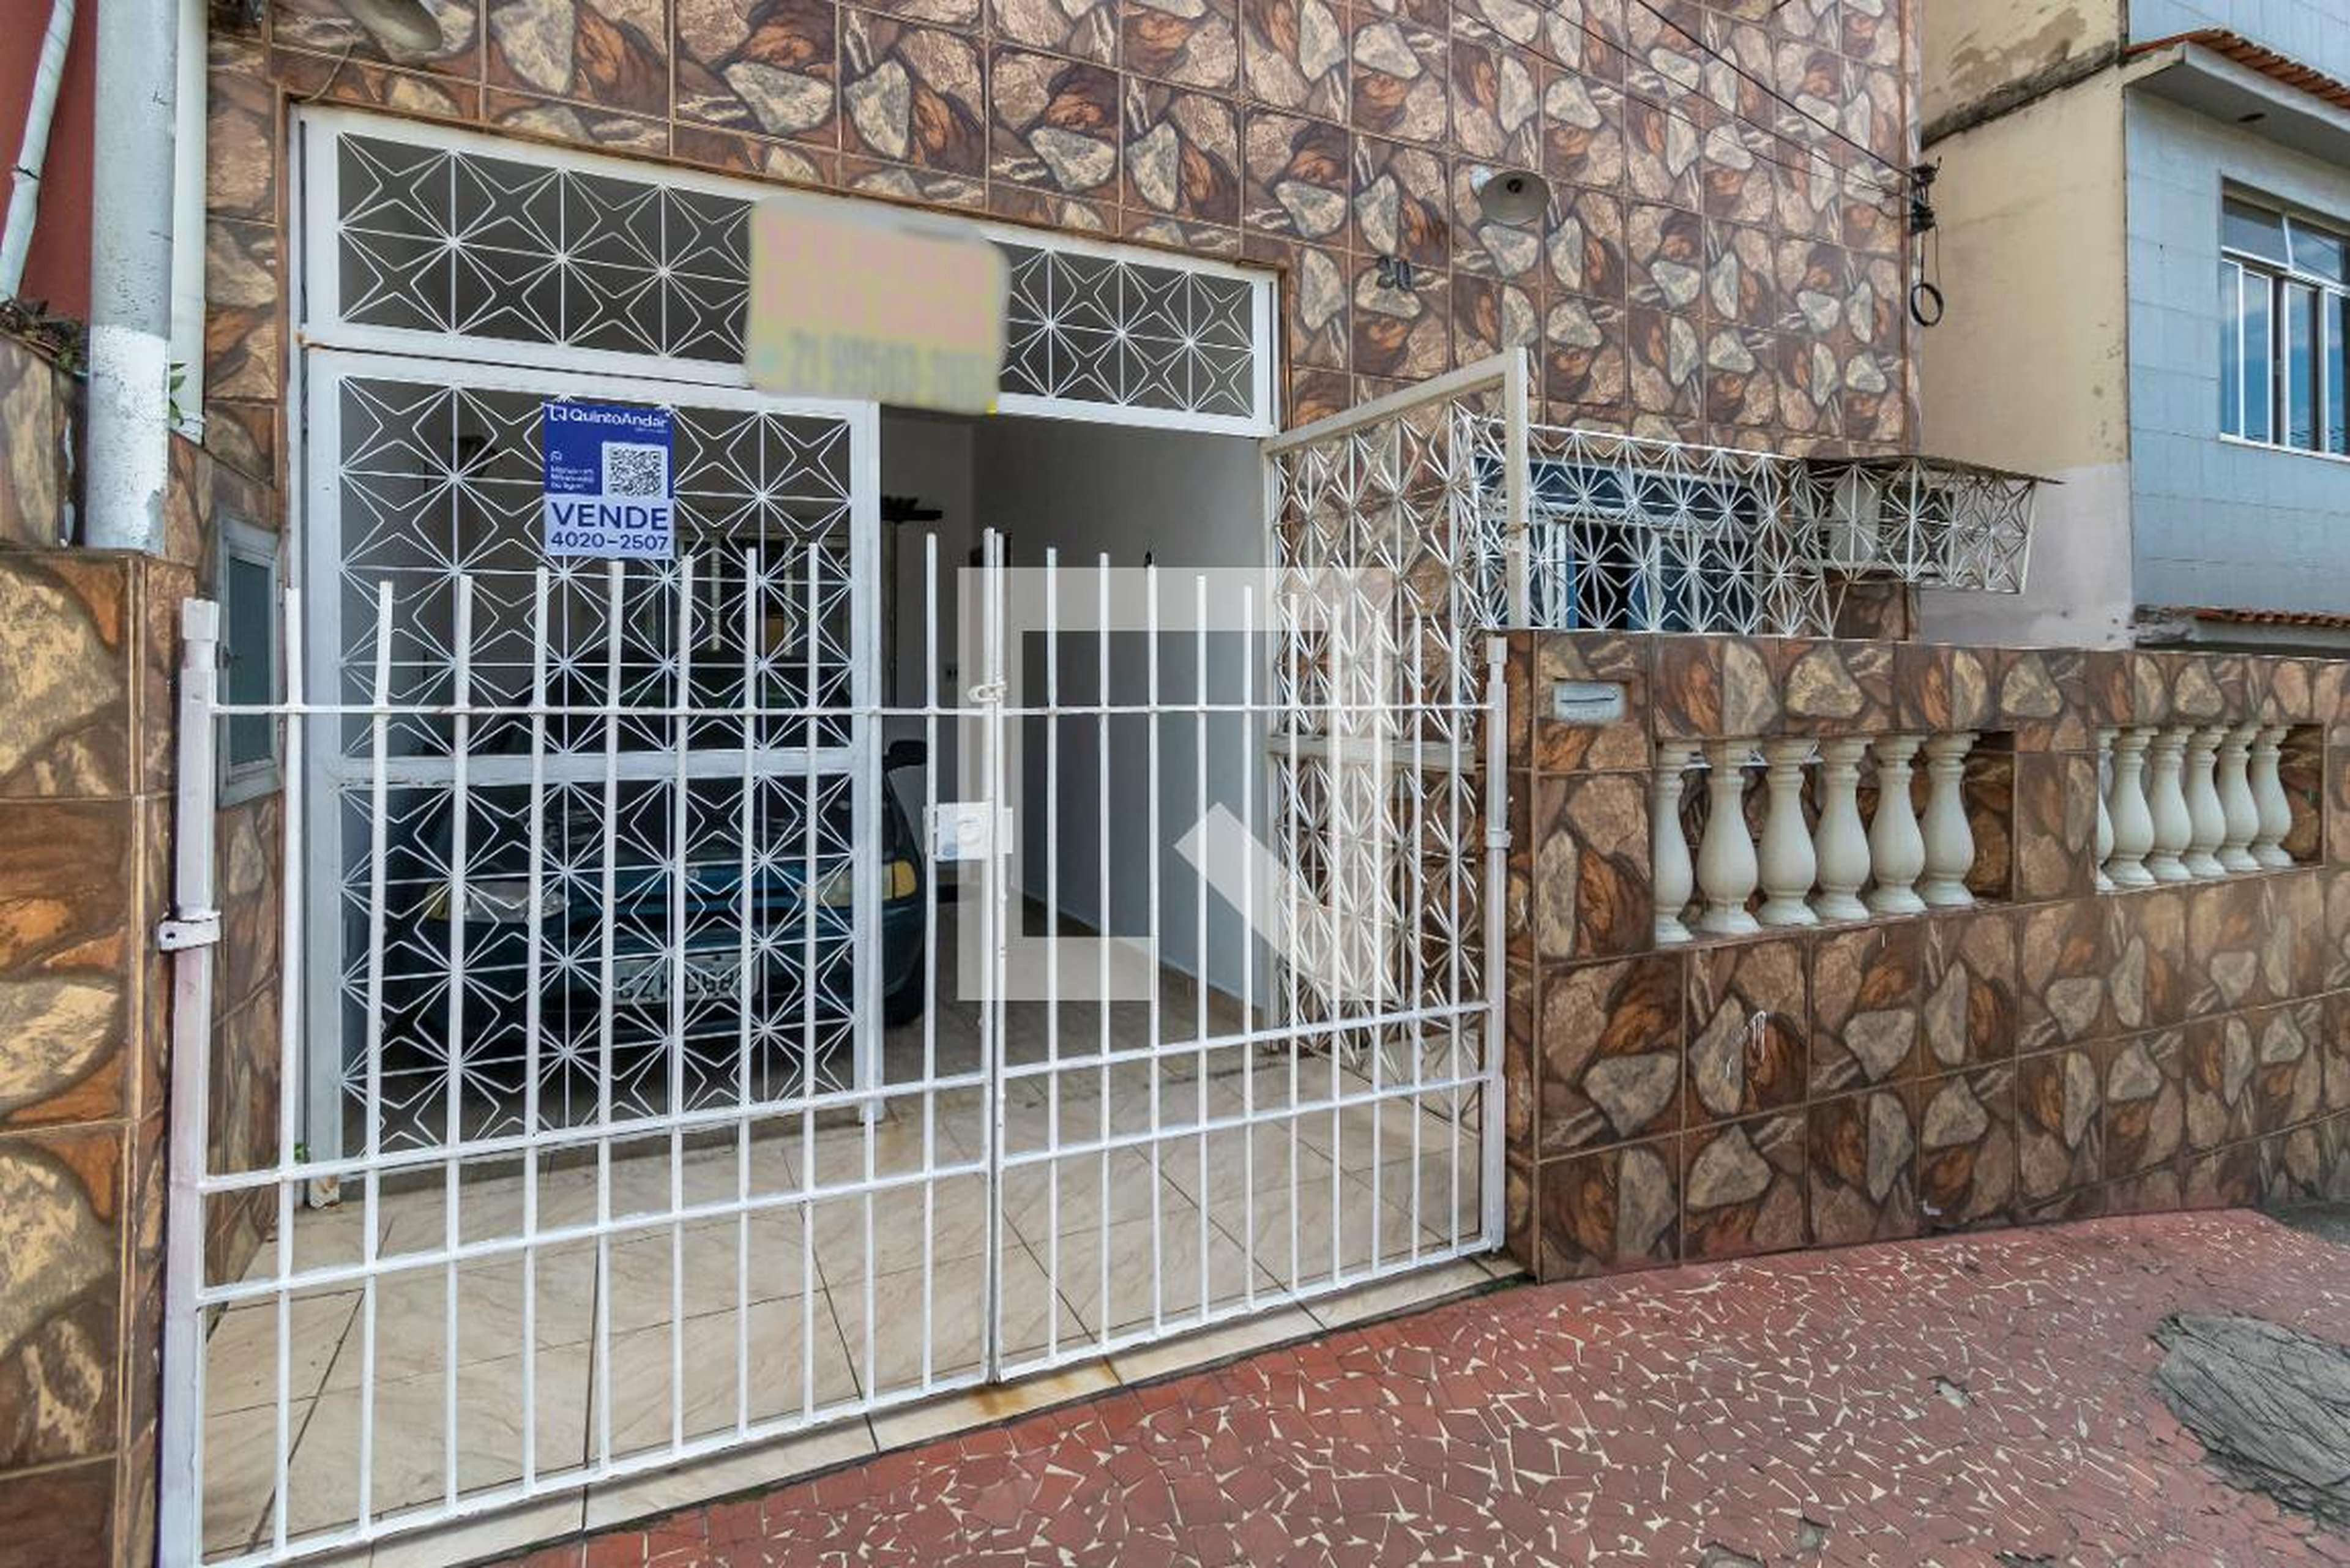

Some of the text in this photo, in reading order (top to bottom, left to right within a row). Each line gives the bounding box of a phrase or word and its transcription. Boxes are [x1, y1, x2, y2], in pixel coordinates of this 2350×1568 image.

[569, 408, 668, 428] QuintoAndar
[551, 502, 668, 531] VENDE
[551, 532, 668, 551] 4020-2507
